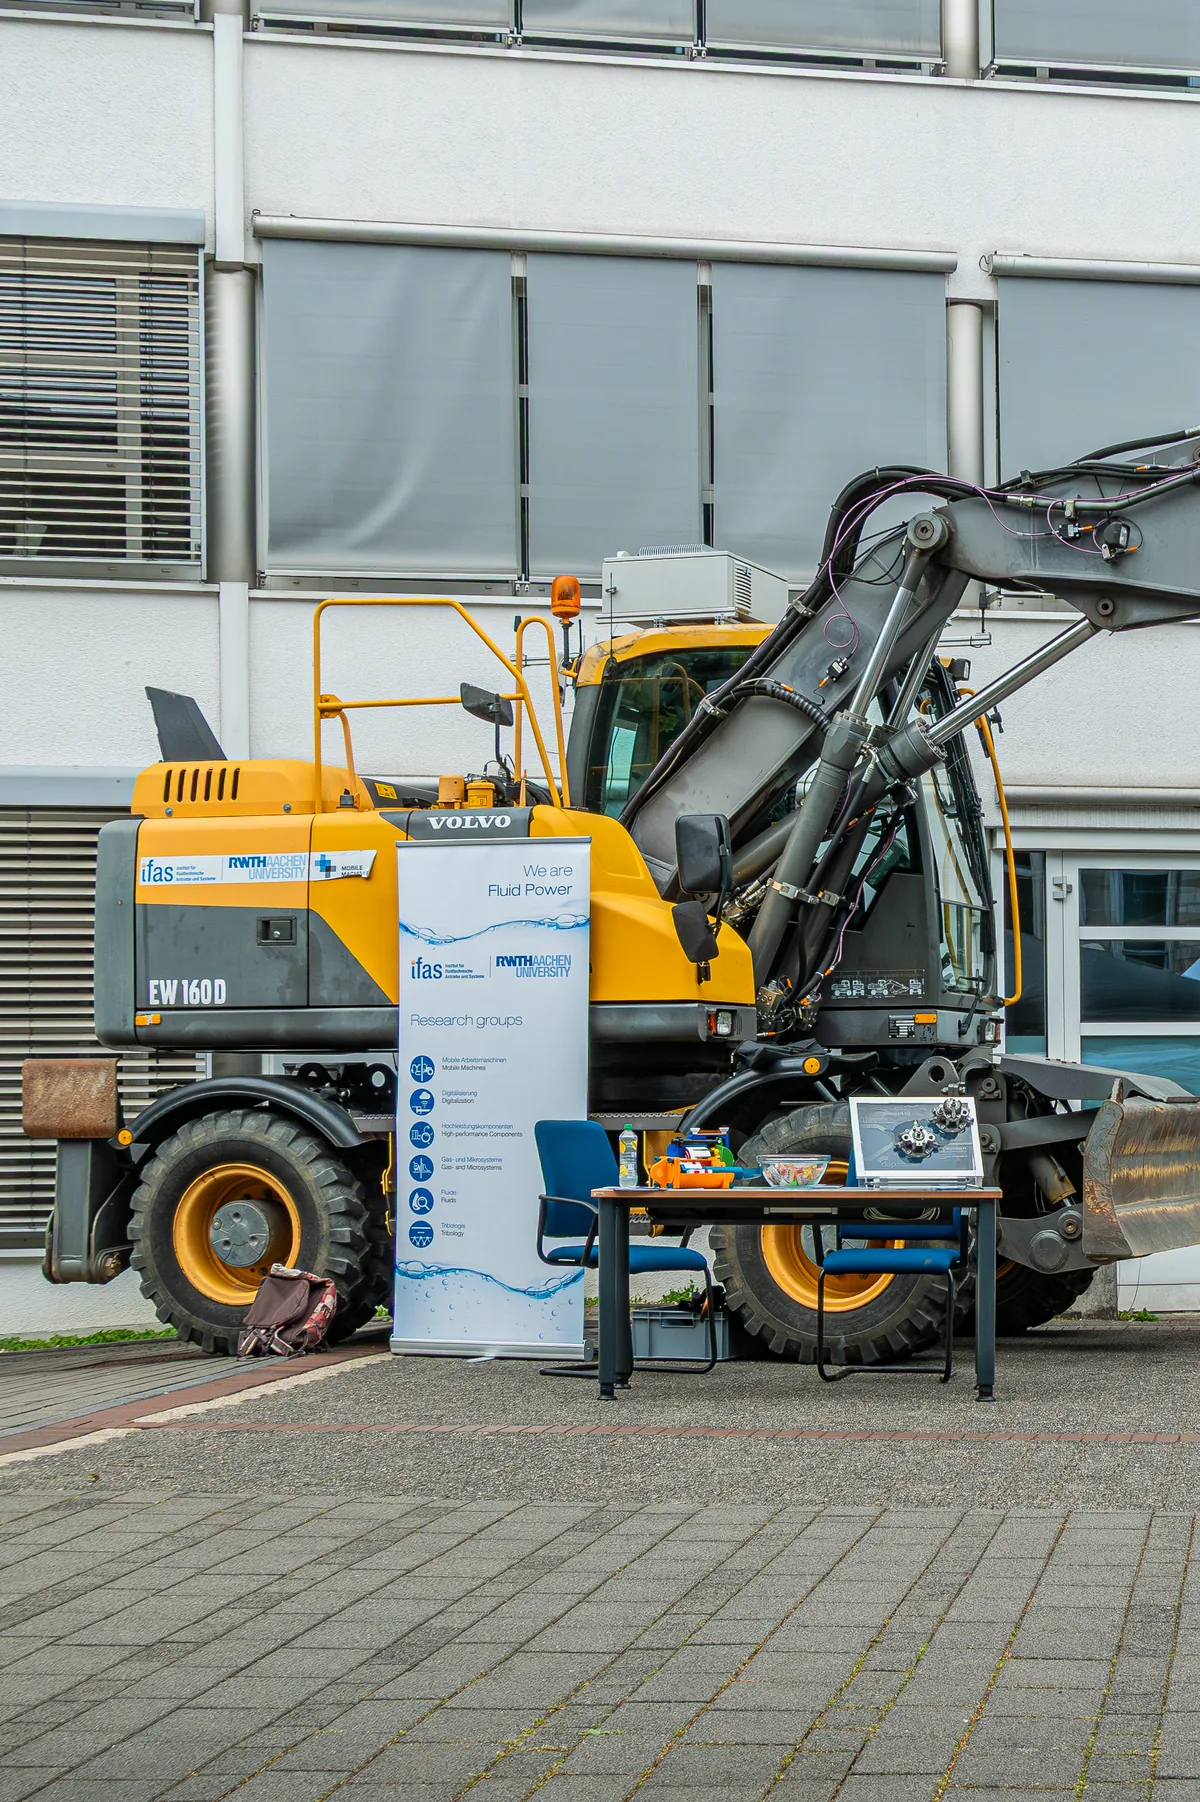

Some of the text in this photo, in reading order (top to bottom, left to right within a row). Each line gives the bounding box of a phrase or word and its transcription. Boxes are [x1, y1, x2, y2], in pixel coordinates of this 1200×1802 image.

[426, 815, 511, 830] VOLVO
[141, 860, 174, 882] ifas
[248, 867, 306, 880] UNIVERSITY
[523, 864, 573, 877] We are
[488, 884, 573, 897] Fluid Power
[410, 957, 442, 980] ifas
[515, 967, 571, 978] UNIVERSITY
[149, 979, 178, 1005] EW
[410, 1014, 523, 1029] Research groups
